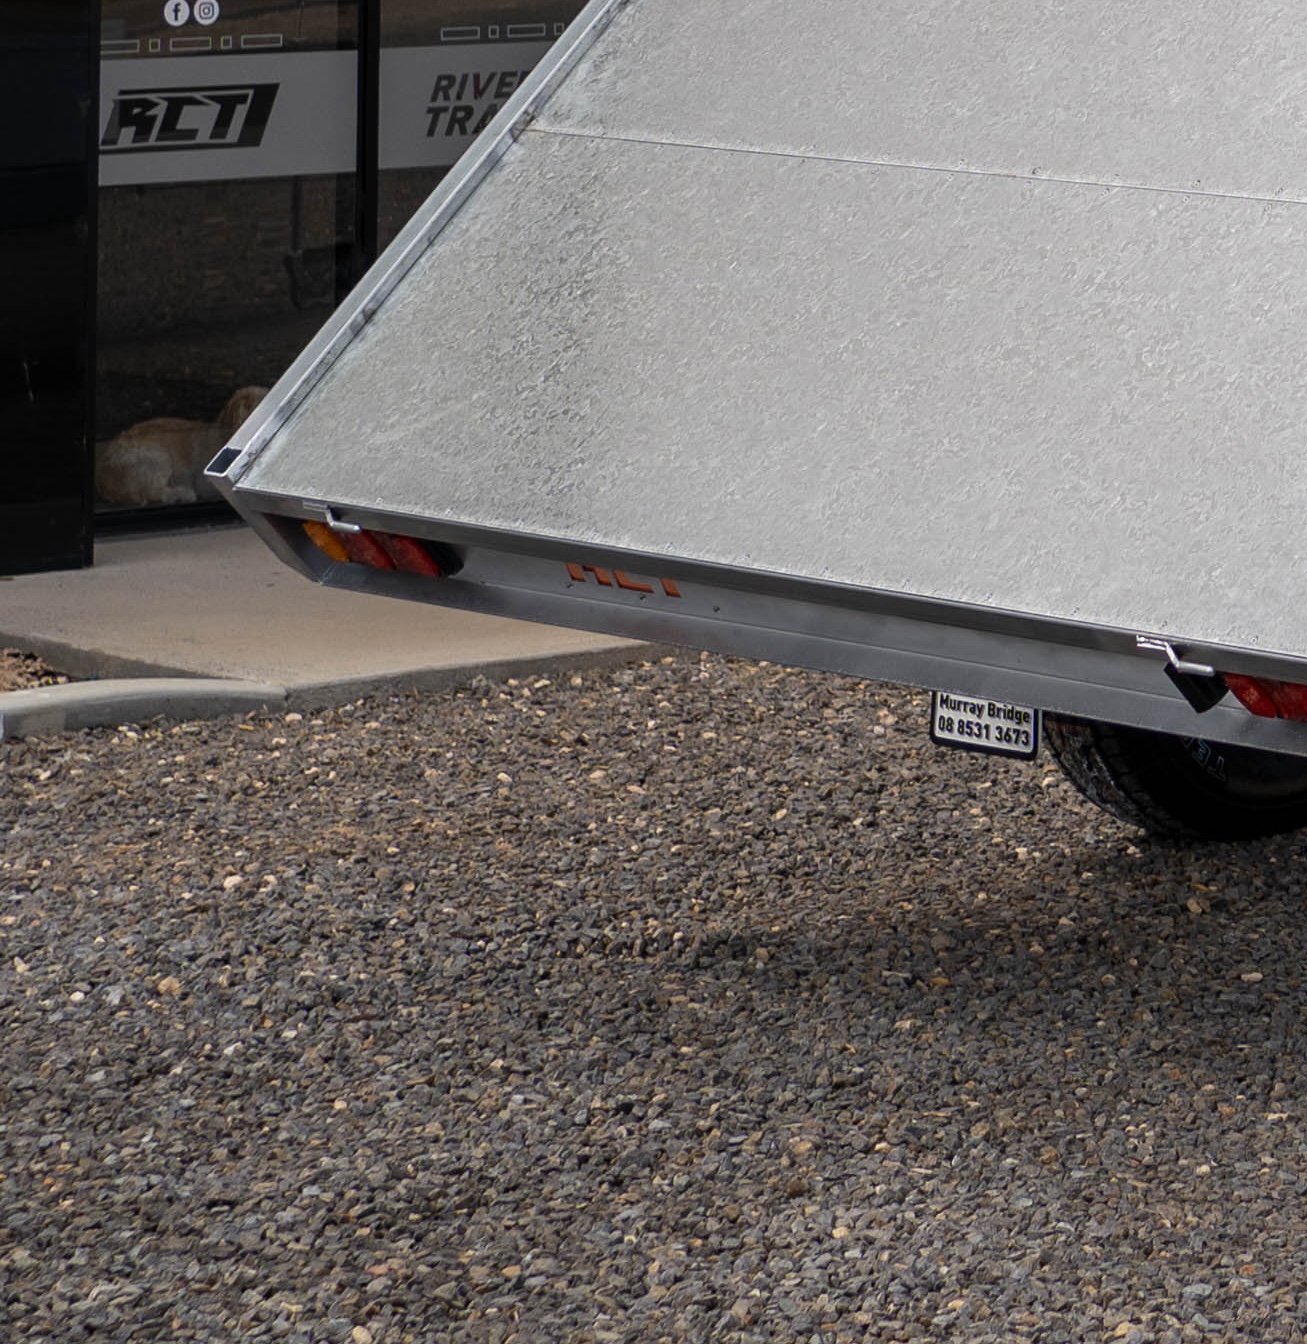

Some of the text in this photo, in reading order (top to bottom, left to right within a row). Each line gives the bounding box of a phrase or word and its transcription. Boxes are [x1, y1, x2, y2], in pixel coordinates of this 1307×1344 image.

[100, 93, 250, 146] RCT
[940, 694, 1030, 725] Murray Bridge
[938, 715, 1030, 746] 08 8531 3673
